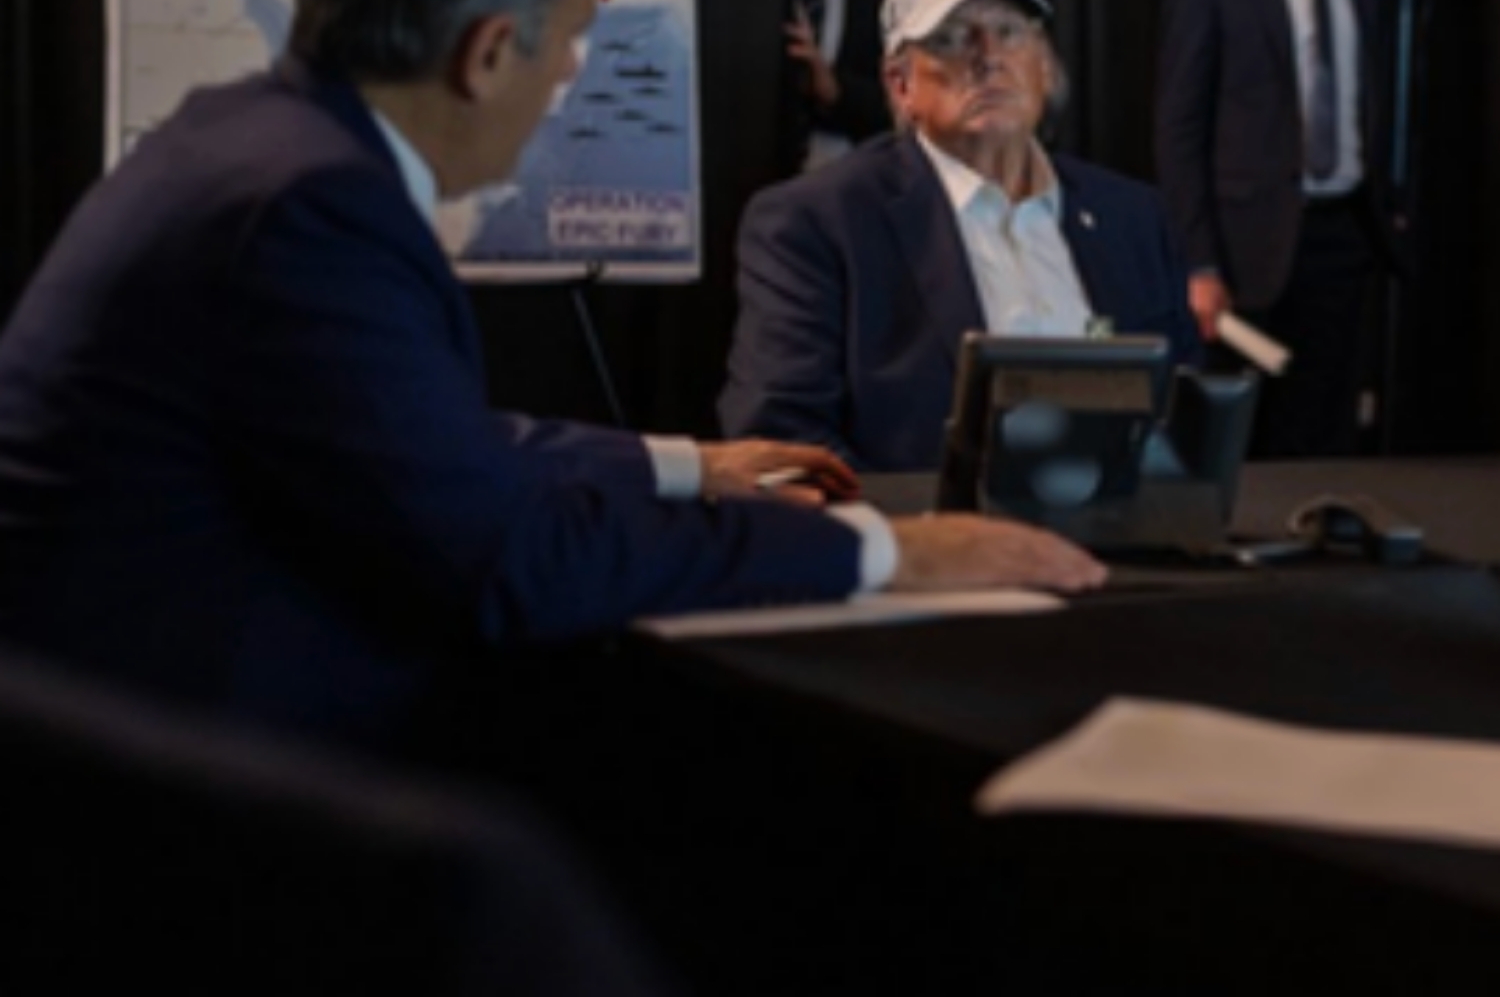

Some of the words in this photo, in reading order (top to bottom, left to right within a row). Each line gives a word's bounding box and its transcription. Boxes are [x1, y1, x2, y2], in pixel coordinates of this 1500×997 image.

[551, 190, 685, 214] OPERATION
[557, 219, 610, 242] EPIC
[617, 220, 678, 244] FURY
